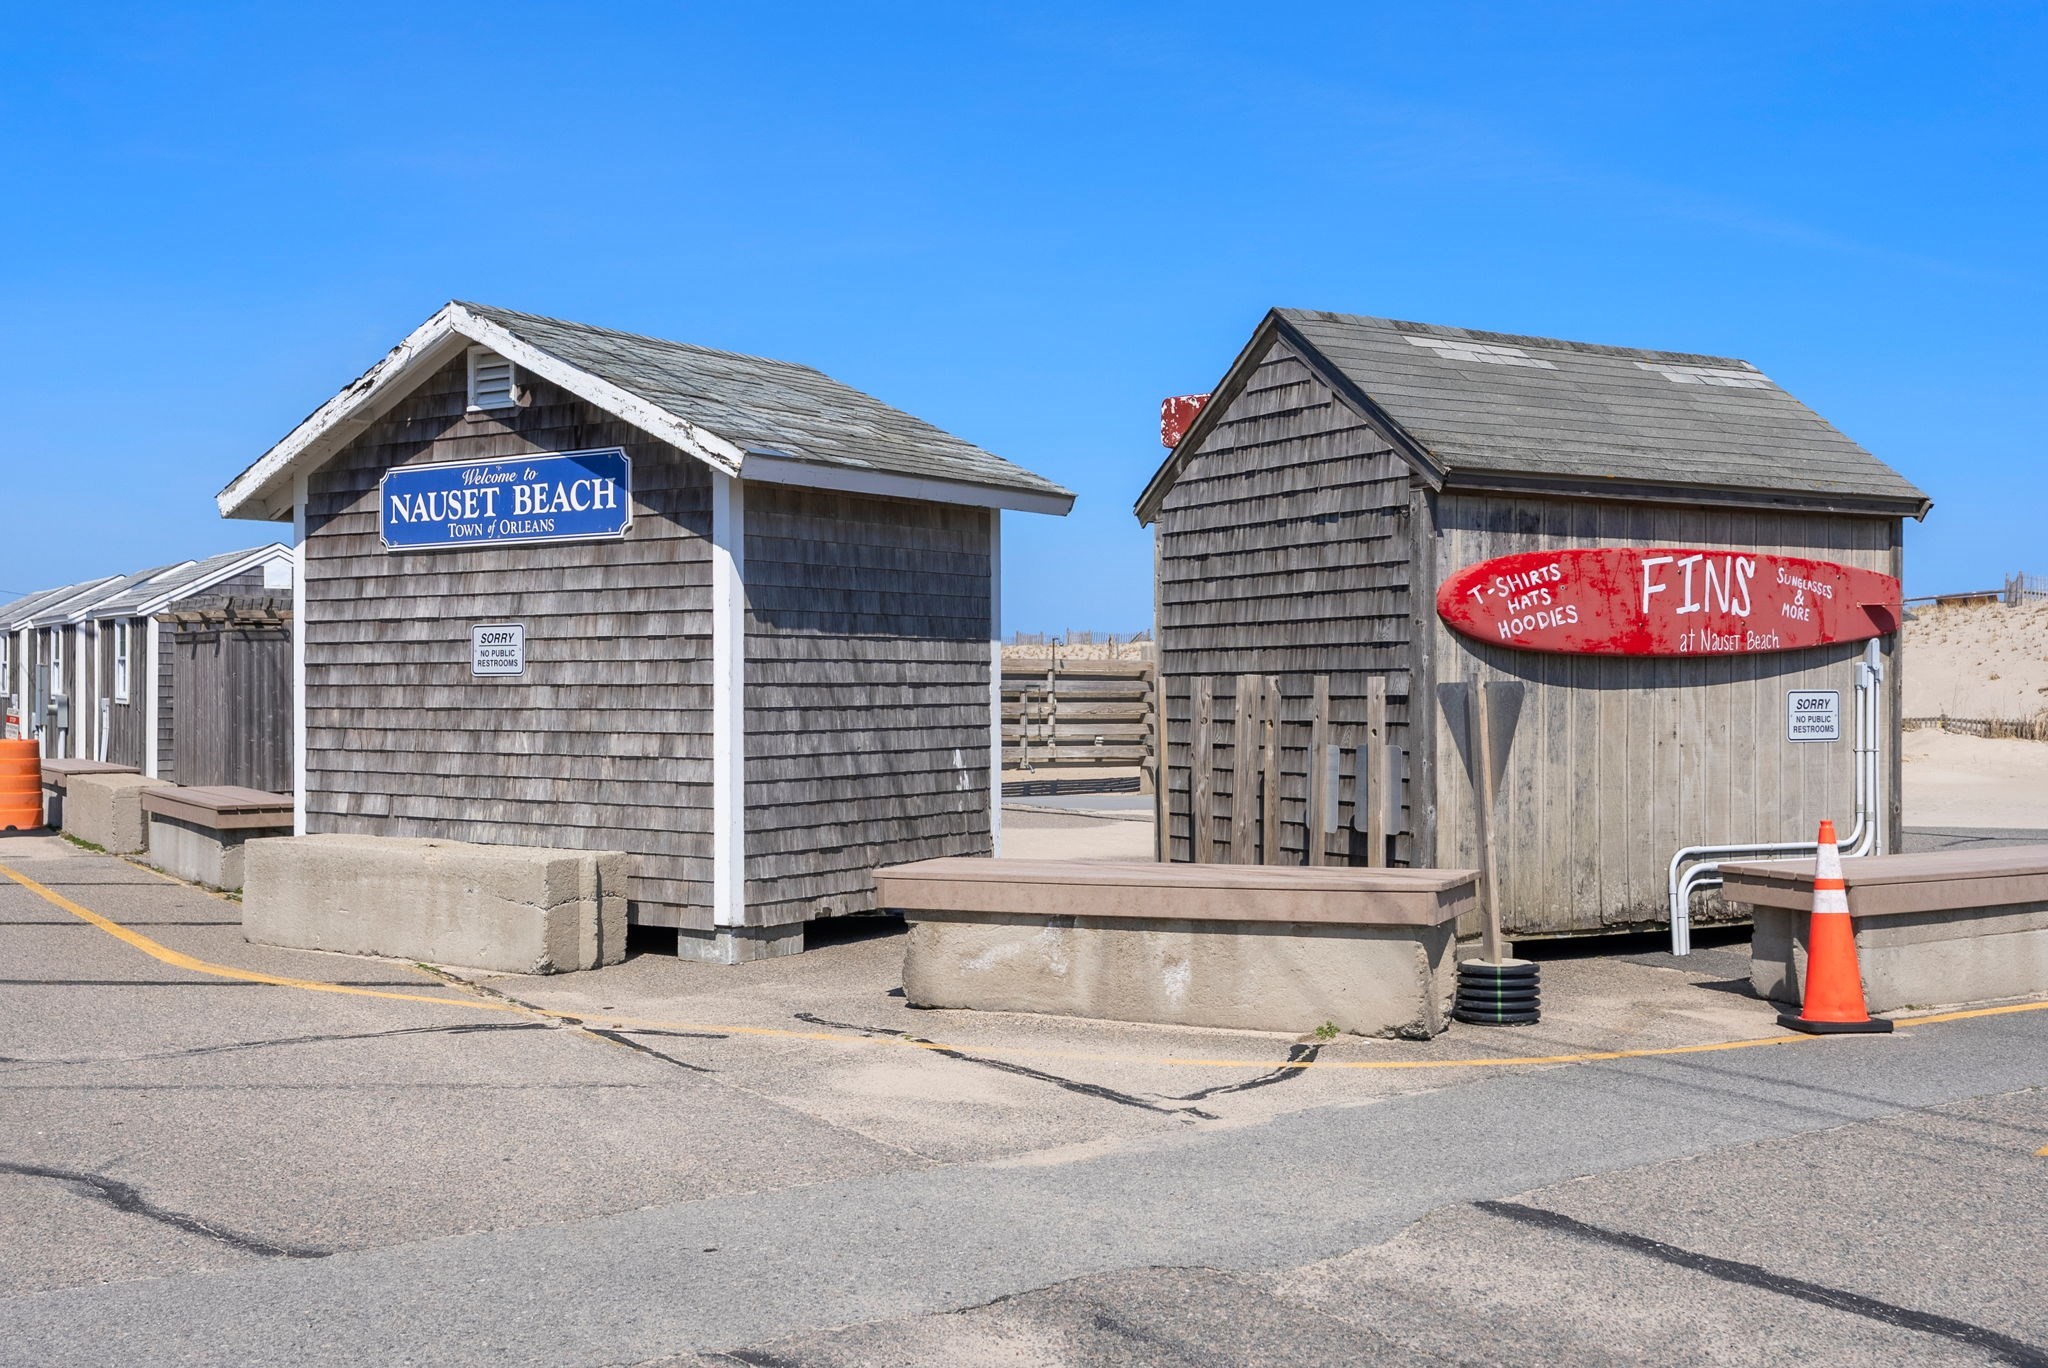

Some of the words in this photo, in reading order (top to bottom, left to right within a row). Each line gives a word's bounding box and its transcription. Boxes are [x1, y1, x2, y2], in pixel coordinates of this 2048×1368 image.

[462, 467, 517, 486] Welcome
[523, 467, 538, 481] to
[390, 487, 500, 524] NAUSET
[512, 478, 616, 515] BEACH
[448, 523, 483, 538] TOWN
[487, 519, 497, 539] of
[500, 518, 555, 535] ORLEANS
[1467, 563, 1561, 604] T-SHIRTS
[1641, 554, 1755, 617] FINS
[1777, 567, 1833, 600] SUNGLASSES
[1507, 587, 1552, 615] HATS
[1794, 589, 1804, 606] &
[1497, 604, 1579, 640] HOODIES
[1781, 602, 1811, 622] MORE
[481, 633, 514, 643] SORRY
[1679, 628, 1696, 653] at
[1746, 628, 1780, 650] Beach
[477, 659, 518, 667] RESTROOMS
[491, 649, 515, 657] PUBLIC
[1796, 699, 1830, 709] SORRY
[1793, 725, 1834, 733] RESTROOMS
[1795, 715, 1806, 723] NO
[1807, 715, 1831, 723] PUBLIC
